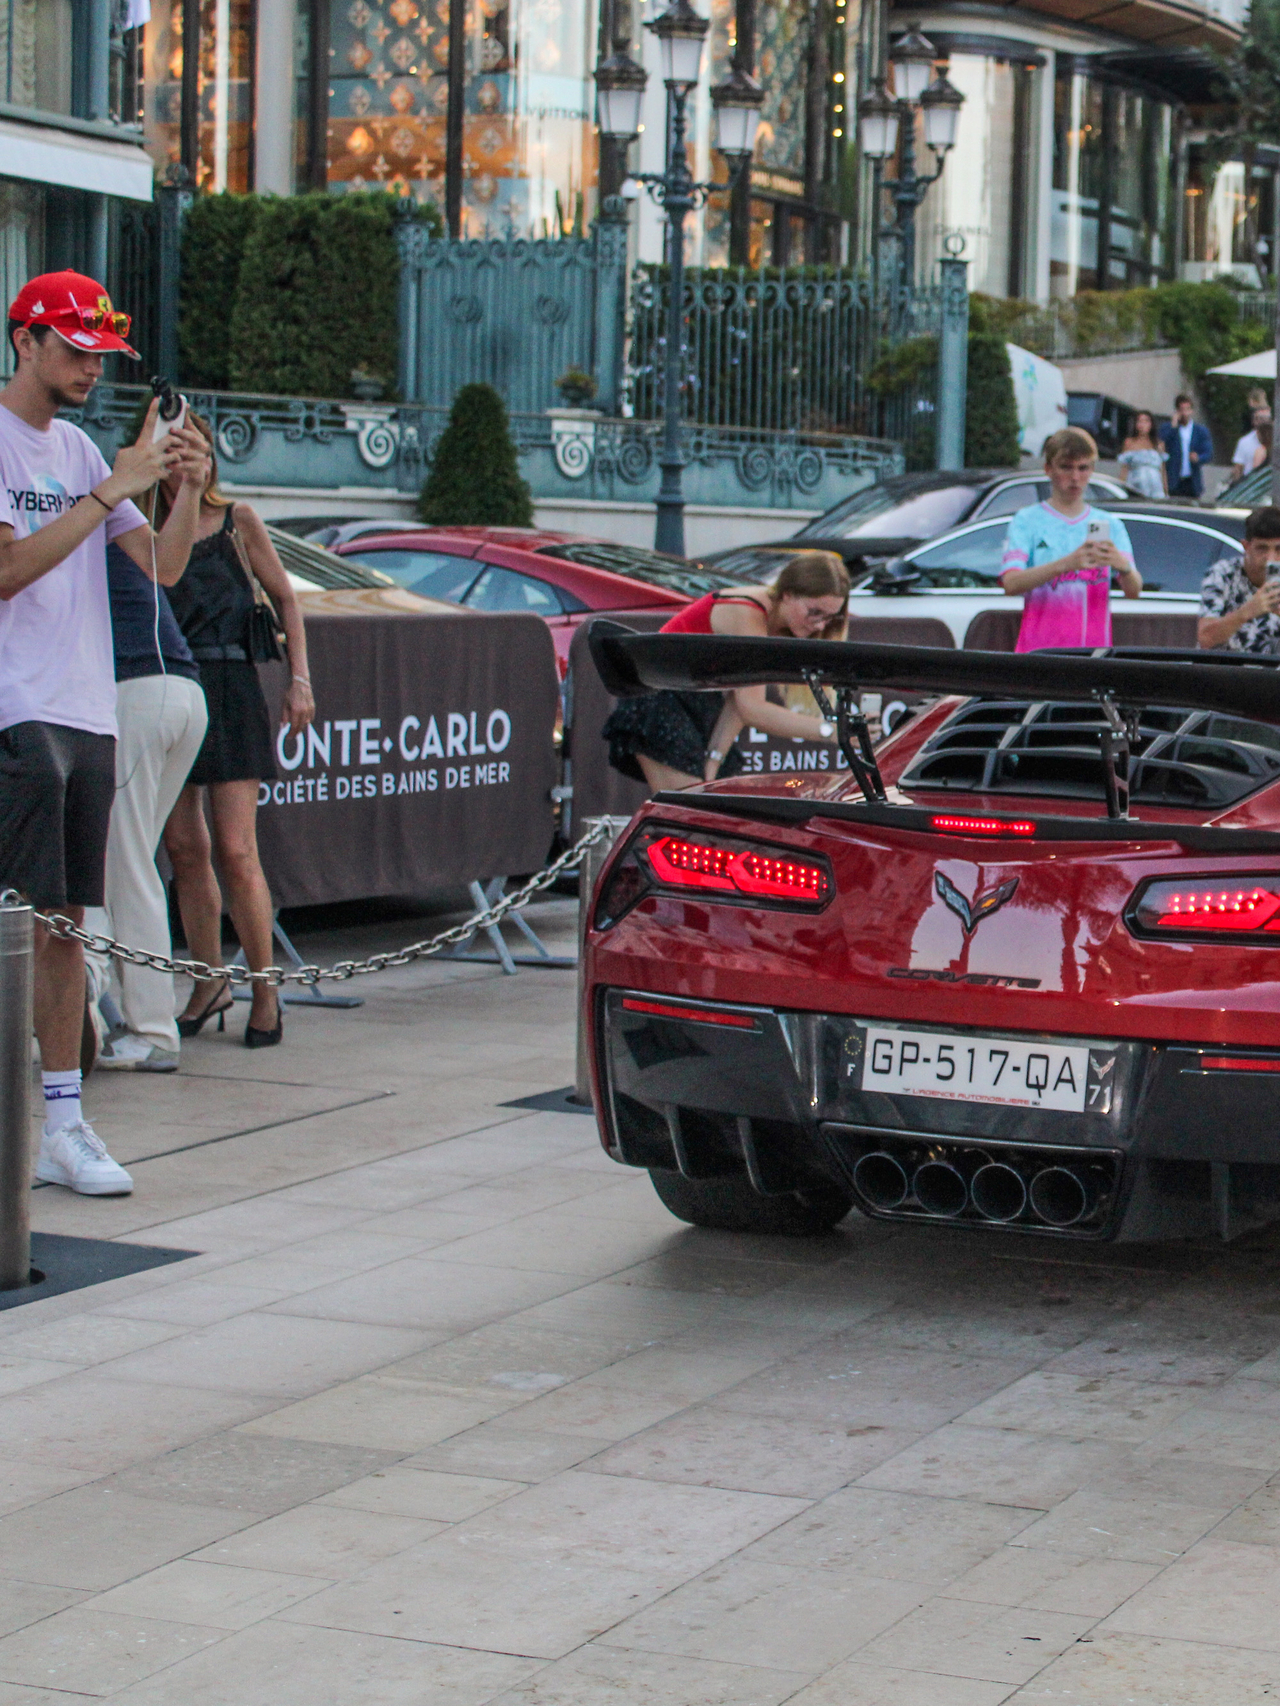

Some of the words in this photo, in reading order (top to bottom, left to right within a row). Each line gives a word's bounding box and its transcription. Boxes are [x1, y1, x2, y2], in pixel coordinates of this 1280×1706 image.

[398, 708, 512, 762] CARLO
[769, 749, 830, 771] BAINS
[257, 772, 329, 806] OCIÉTÉ
[335, 774, 377, 800] DES
[382, 768, 438, 796] BAINS
[445, 765, 471, 789] DE
[475, 761, 511, 786] MER
[887, 967, 1042, 989] CORVETTE
[846, 1063, 855, 1077] F
[871, 1038, 1078, 1098] GP-517-QA
[1089, 1084, 1111, 1106] 71
